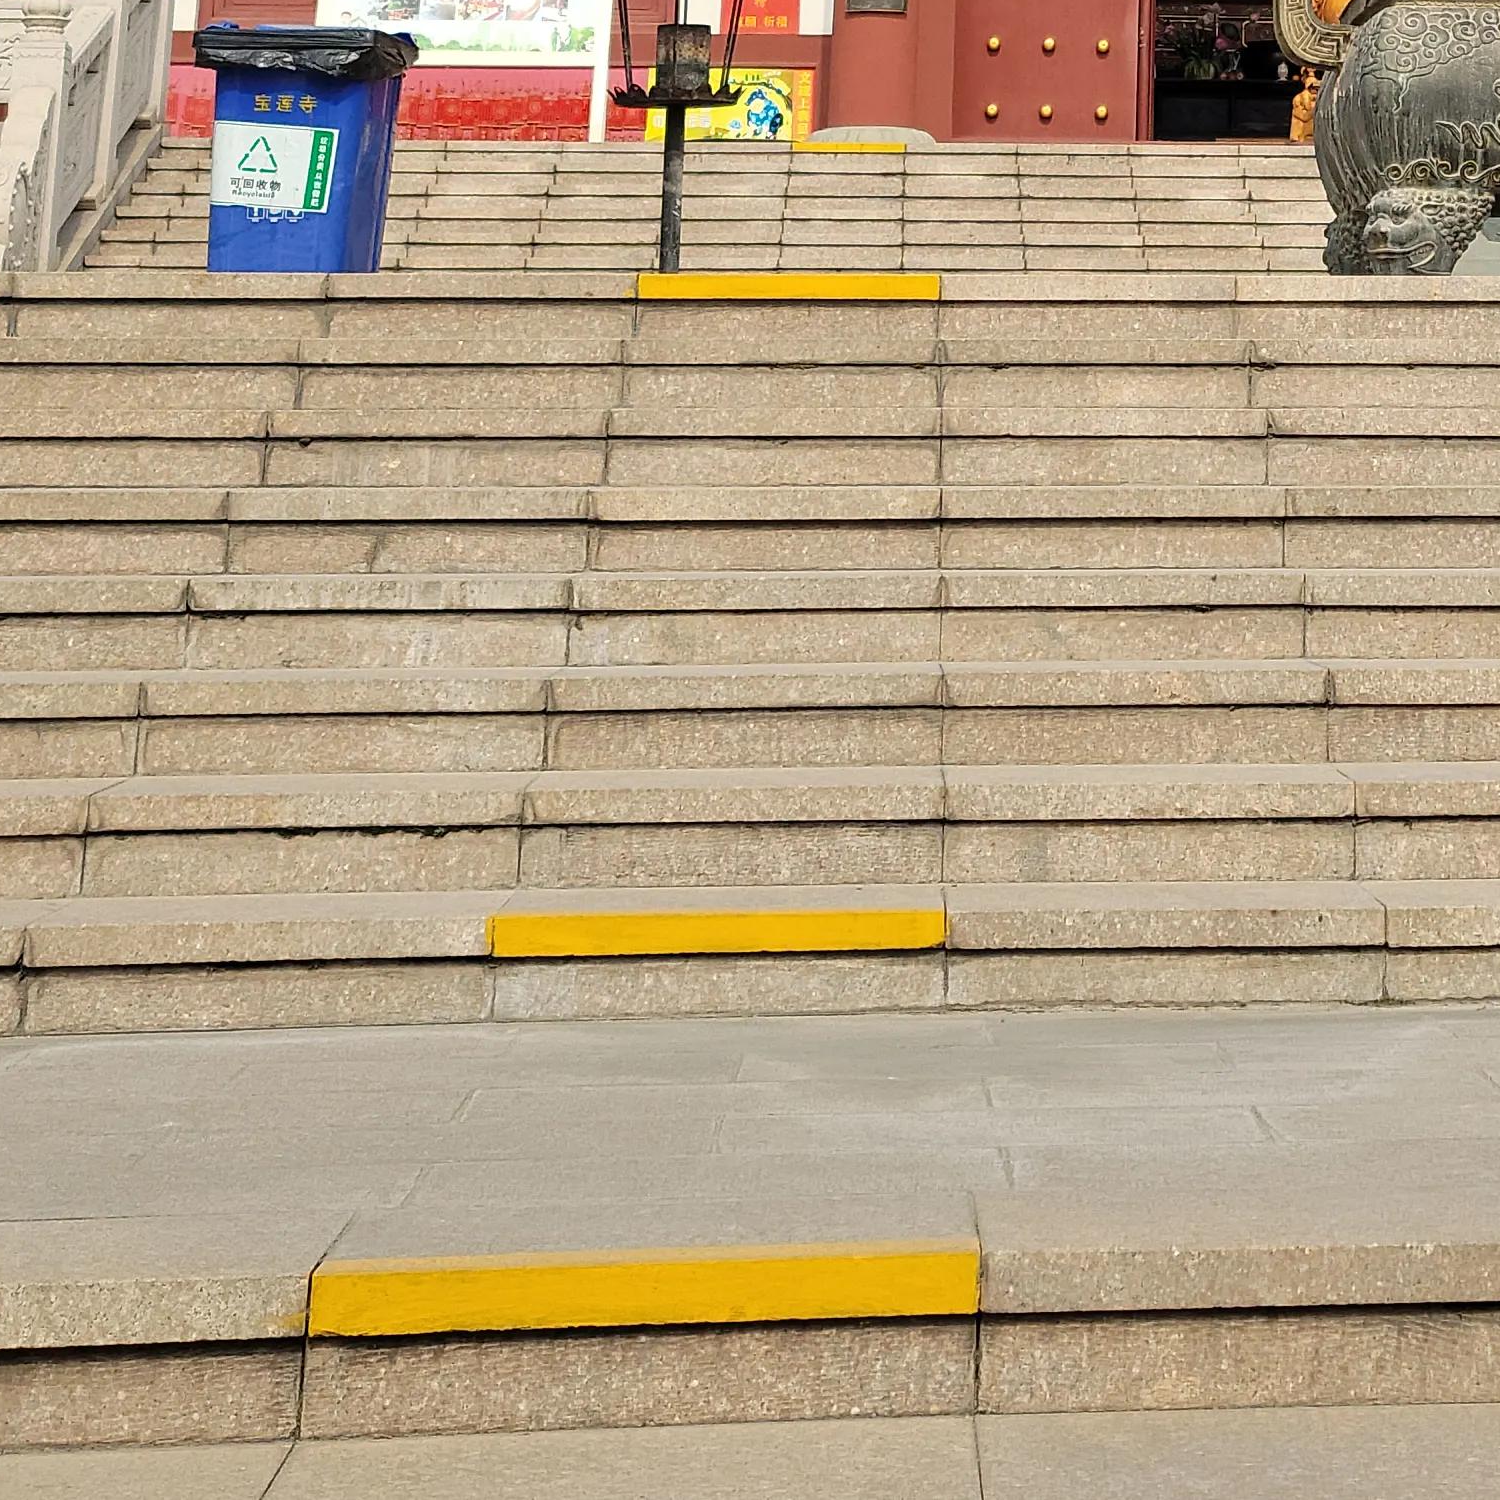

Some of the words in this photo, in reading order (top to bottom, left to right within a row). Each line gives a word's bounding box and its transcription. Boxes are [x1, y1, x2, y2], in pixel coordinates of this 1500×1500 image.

[253, 93, 318, 114] 宝莲寺
[230, 177, 282, 192] 可回收物
